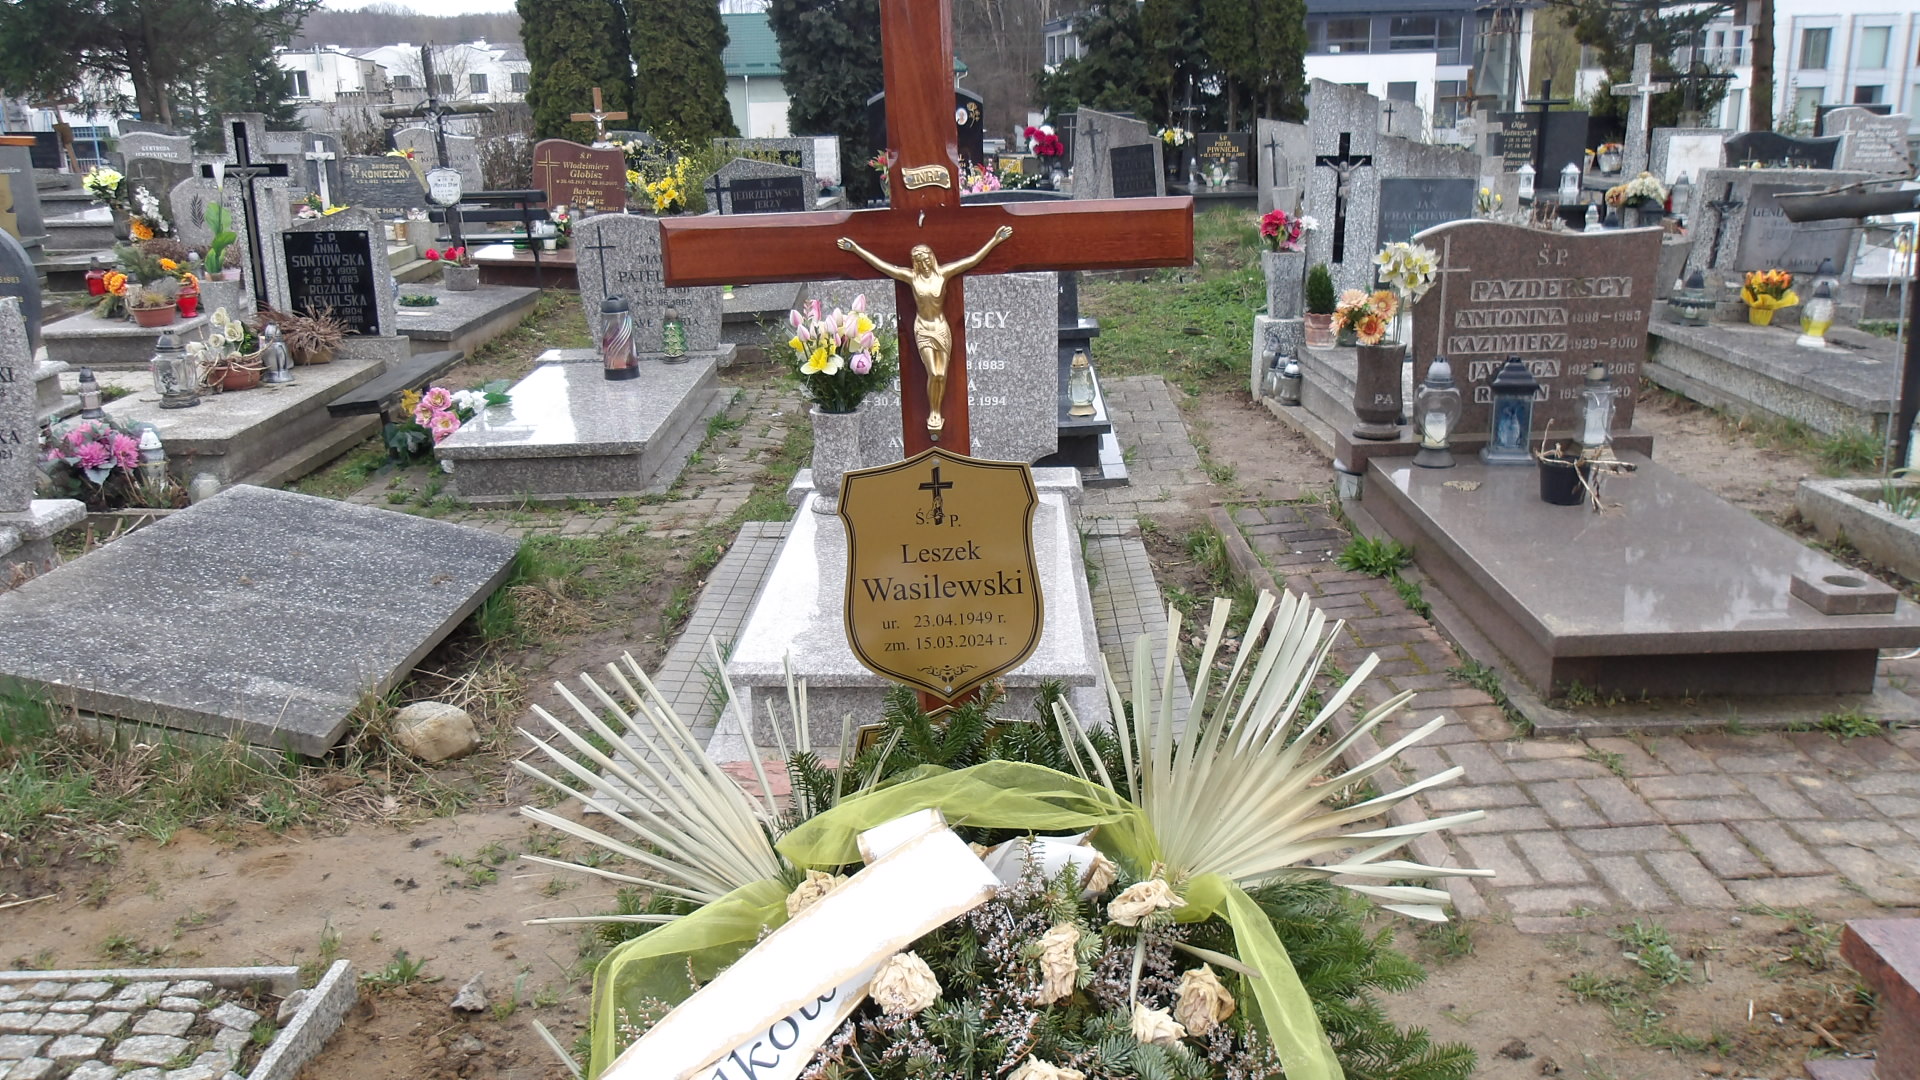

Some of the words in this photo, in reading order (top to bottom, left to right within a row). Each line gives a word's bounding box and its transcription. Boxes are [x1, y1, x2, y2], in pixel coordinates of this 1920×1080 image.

[361, 170, 411, 179] KONIECZNY
[570, 170, 603, 179] Globisz
[913, 170, 941, 184] INRI
[573, 188, 603, 196] Barbara
[755, 201, 781, 210] JERZY
[1416, 200, 1438, 209] JAN
[313, 244, 341, 254] ANNA
[291, 254, 365, 268] SONTOWSKA
[310, 285, 354, 295] ROZALIA
[1472, 278, 1632, 300] PAZDERSCY
[299, 294, 367, 308] JASKULSKA
[1456, 309, 1568, 327] ANTONINA
[1448, 334, 1568, 353] KAZIMIERZ
[1374, 393, 1394, 404] PA
[901, 540, 982, 564] Leszek
[861, 569, 1024, 603] Wasilewski
[882, 617, 900, 630] ur.
[914, 611, 993, 628] 23.04.1949
[998, 614, 1006, 624] r.
[884, 641, 910, 653] zm.
[917, 633, 993, 650] 15.03.2024
[999, 636, 1007, 646] r.
